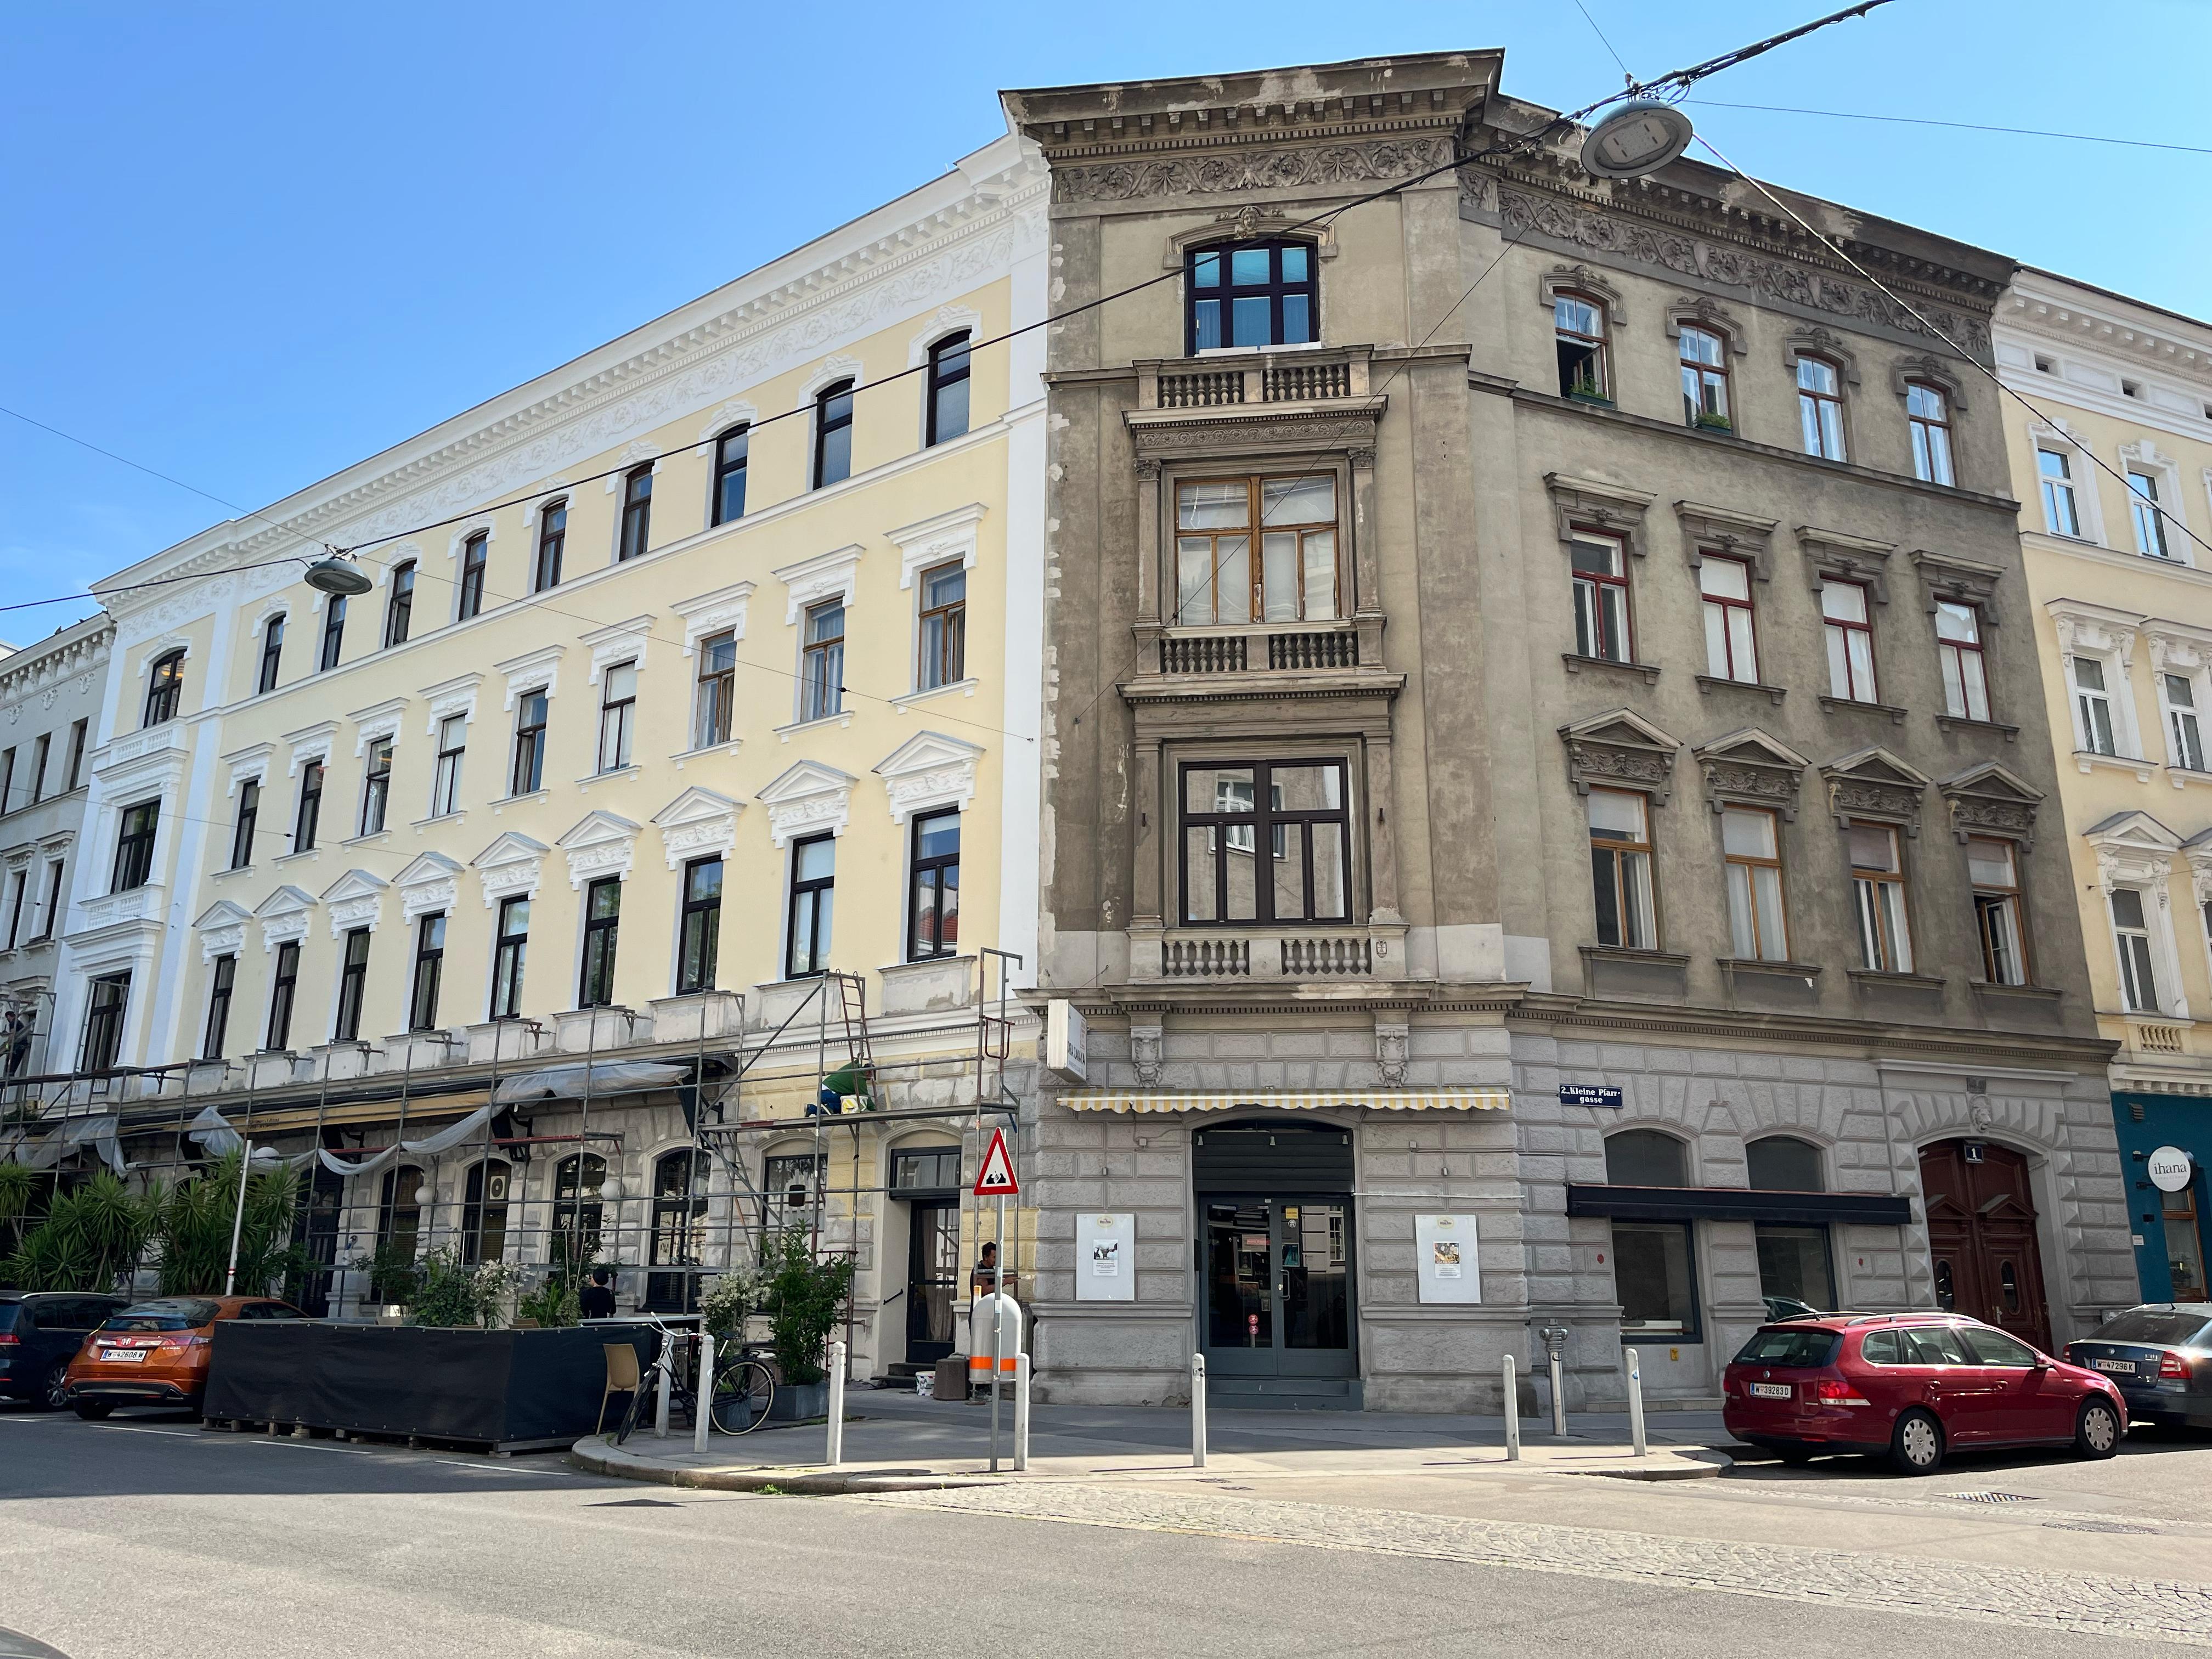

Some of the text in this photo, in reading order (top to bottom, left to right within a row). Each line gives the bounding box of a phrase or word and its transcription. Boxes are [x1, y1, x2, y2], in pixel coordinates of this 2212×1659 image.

[1570, 1087, 1596, 1096] Kleine
[1598, 1088, 1621, 1097] Pfarr-
[1971, 1148, 1977, 1158] 1
[2154, 1163, 2187, 1174] ihana
